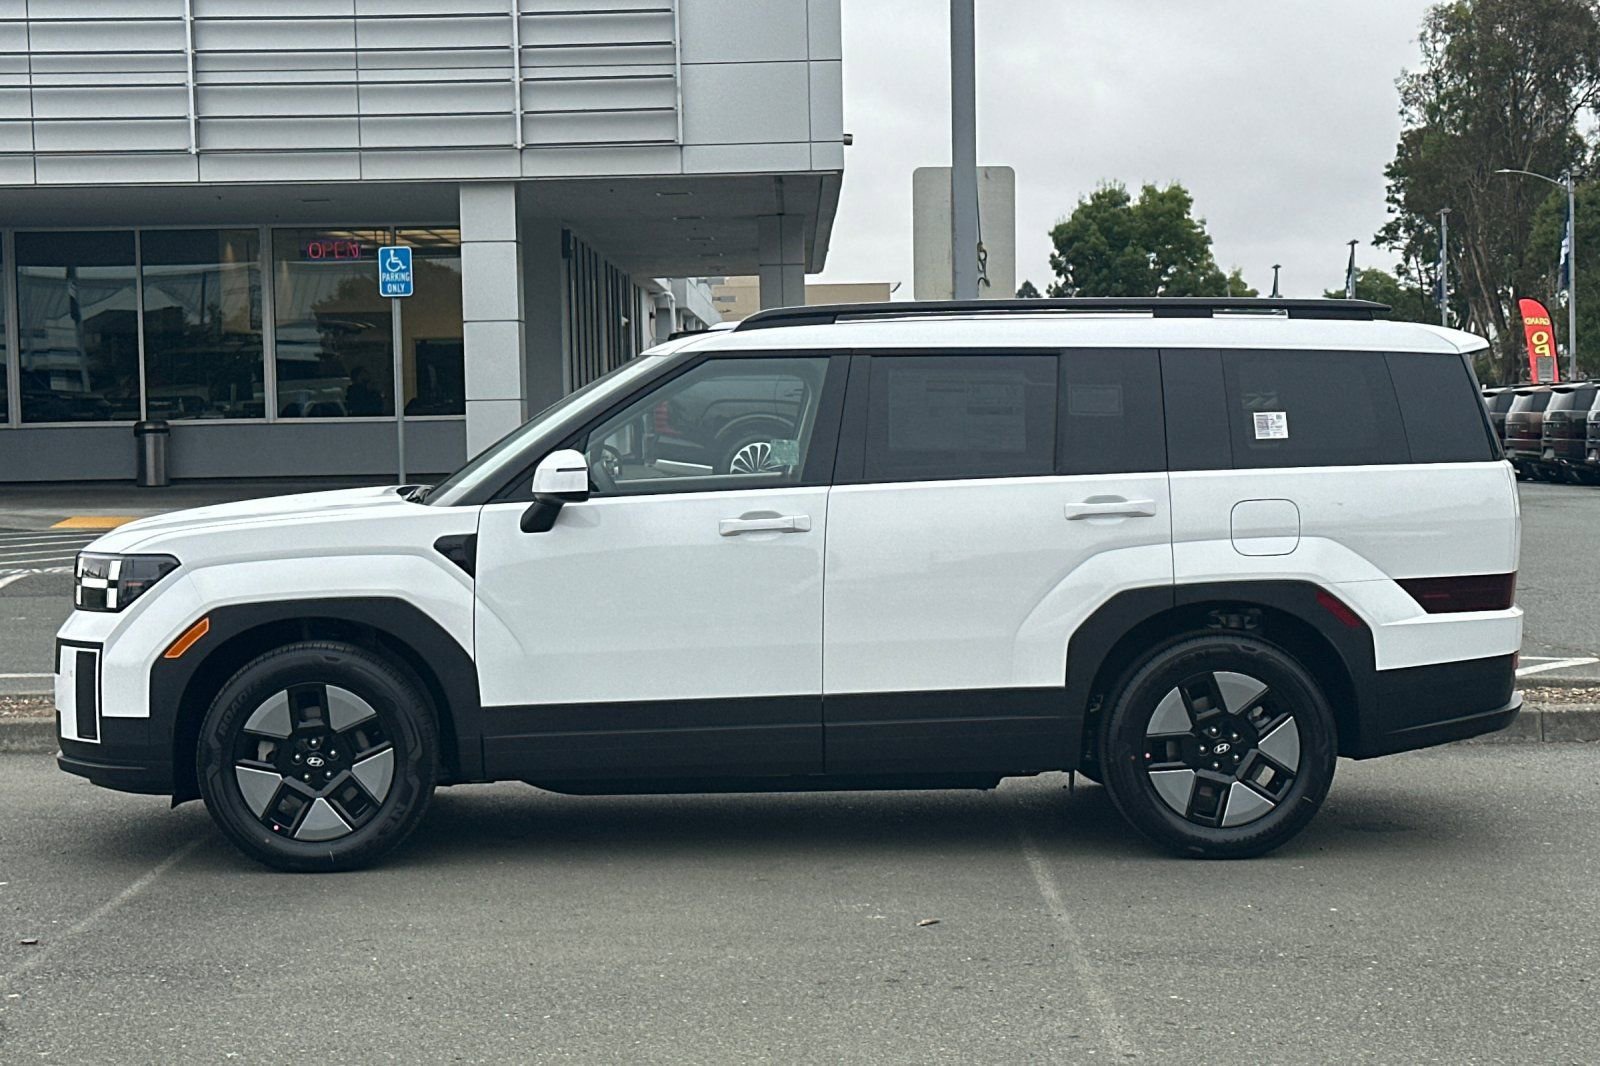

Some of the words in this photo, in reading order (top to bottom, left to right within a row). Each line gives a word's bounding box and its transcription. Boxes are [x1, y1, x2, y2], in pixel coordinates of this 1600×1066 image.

[308, 241, 359, 259] OPEN
[382, 272, 410, 282] PARKING
[387, 283, 405, 293] ONLY
